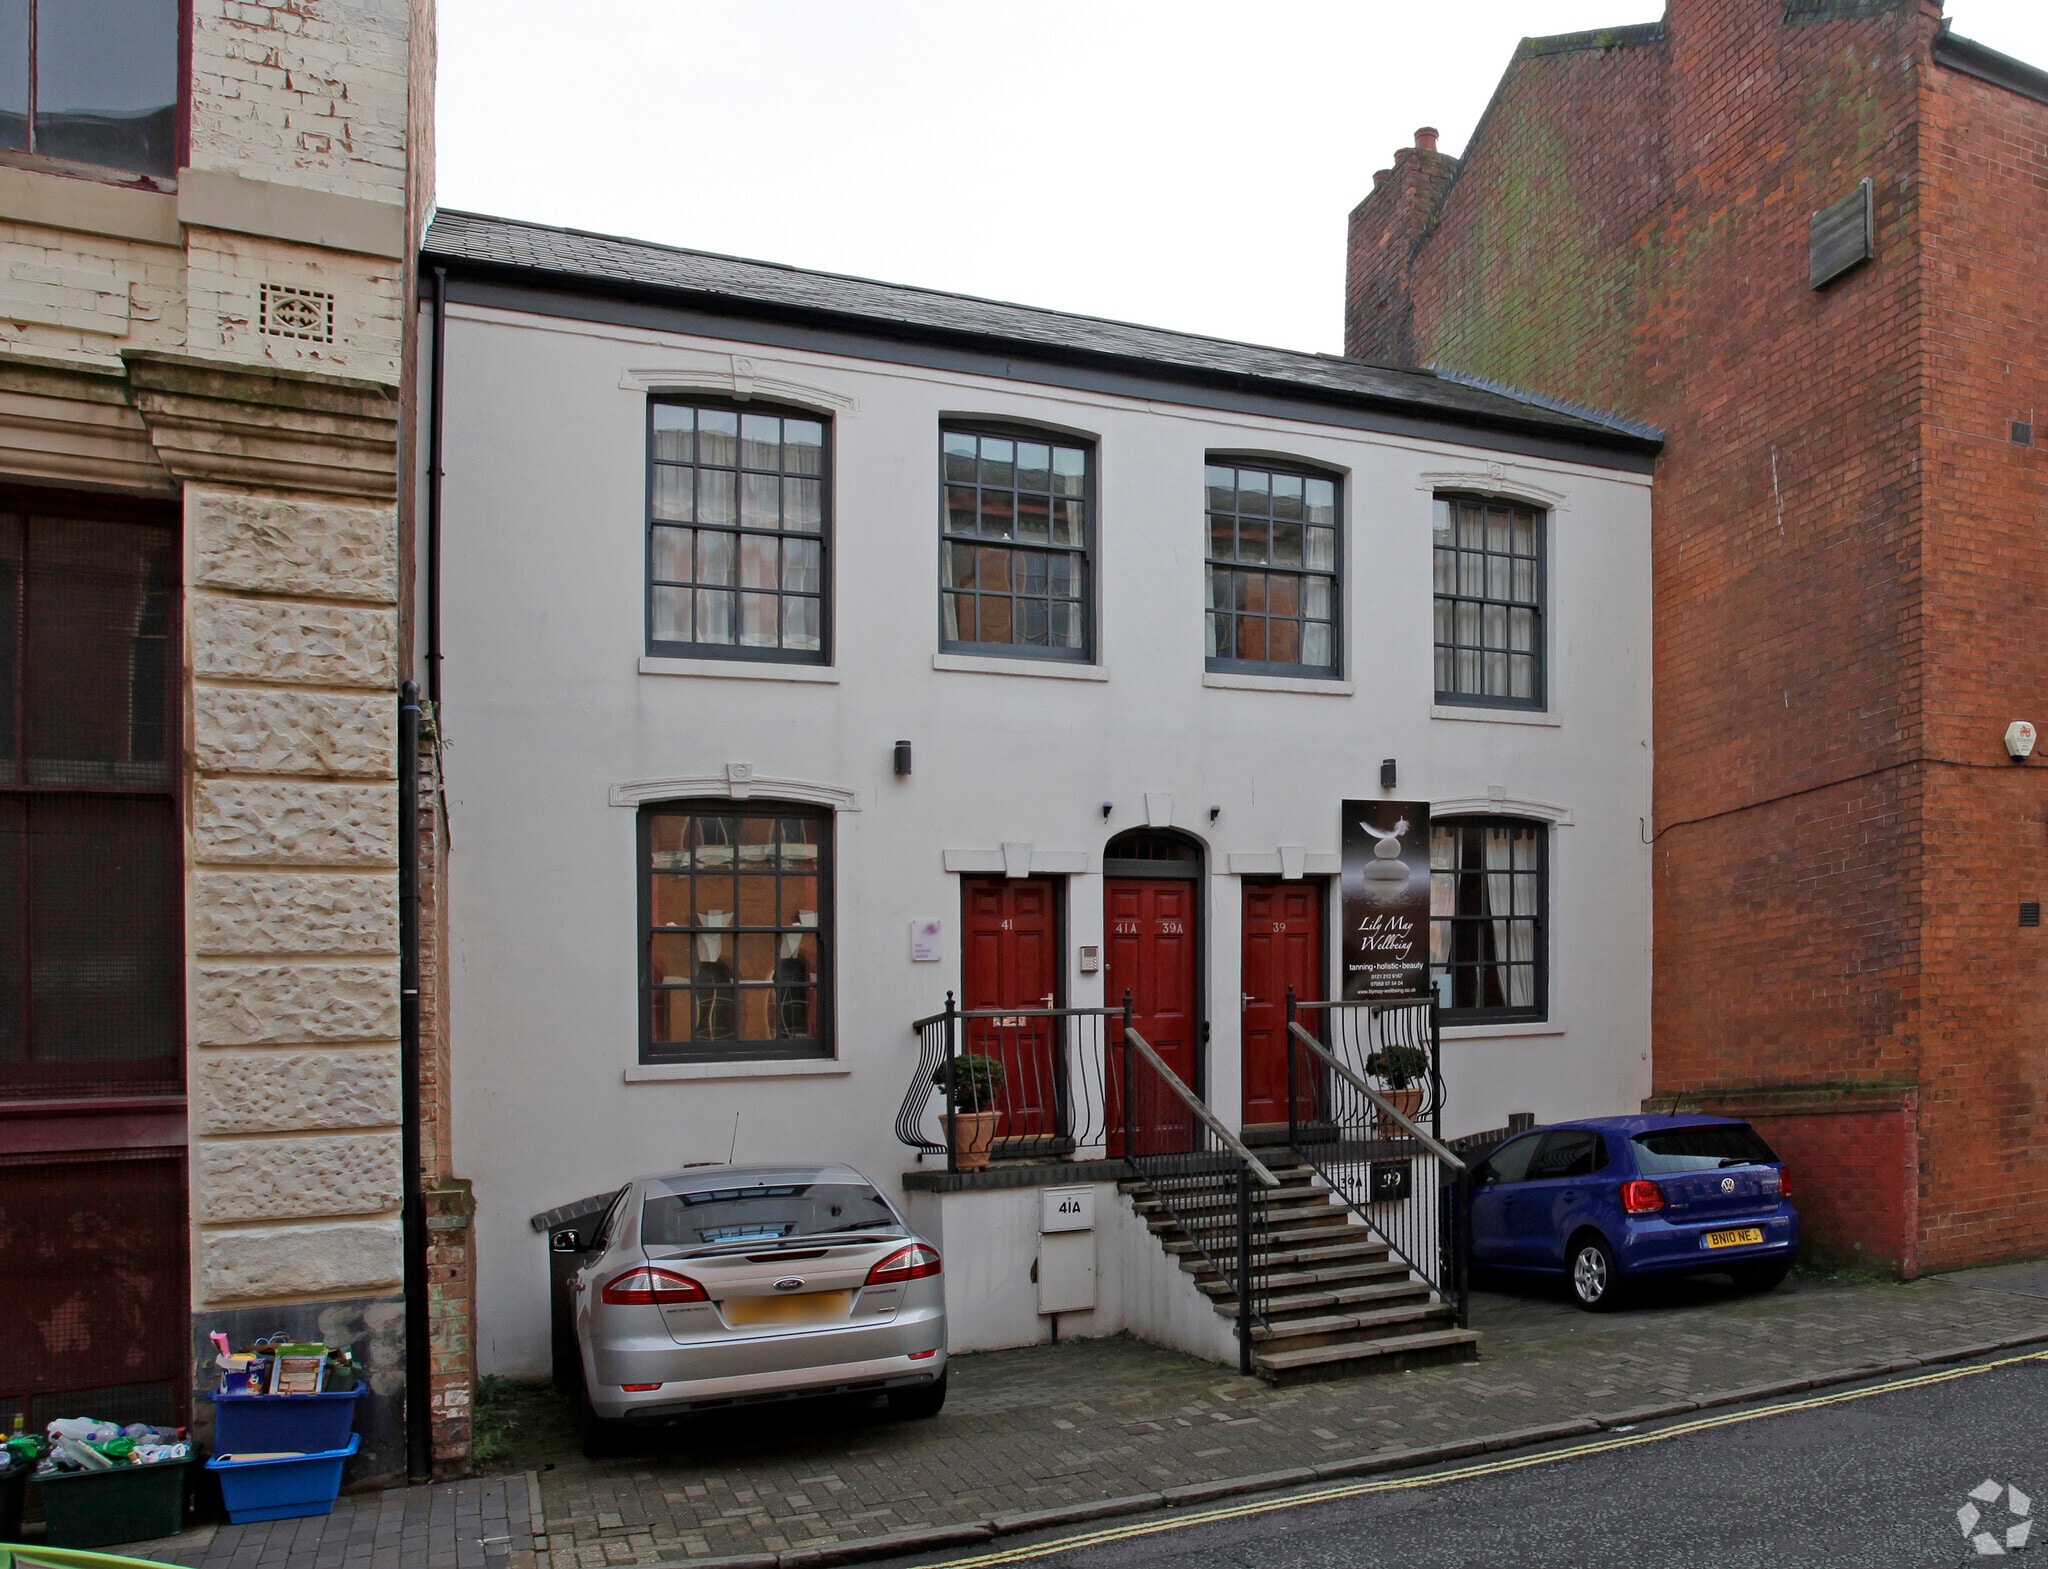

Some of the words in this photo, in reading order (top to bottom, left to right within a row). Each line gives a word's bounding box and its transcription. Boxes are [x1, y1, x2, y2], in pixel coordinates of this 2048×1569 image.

[1001, 919, 1013, 930] 41
[1115, 923, 1137, 934] 41A
[1162, 922, 1183, 934] 39A
[1272, 922, 1286, 933] 39
[1358, 914, 1383, 938] Lily
[1384, 915, 1413, 938] May
[1361, 934, 1413, 960] Wellbeing
[1340, 1177, 1363, 1189] 39A
[1381, 1172, 1401, 1188] 39
[1059, 1201, 1081, 1214] 41A
[1711, 1231, 1736, 1245] BN10
